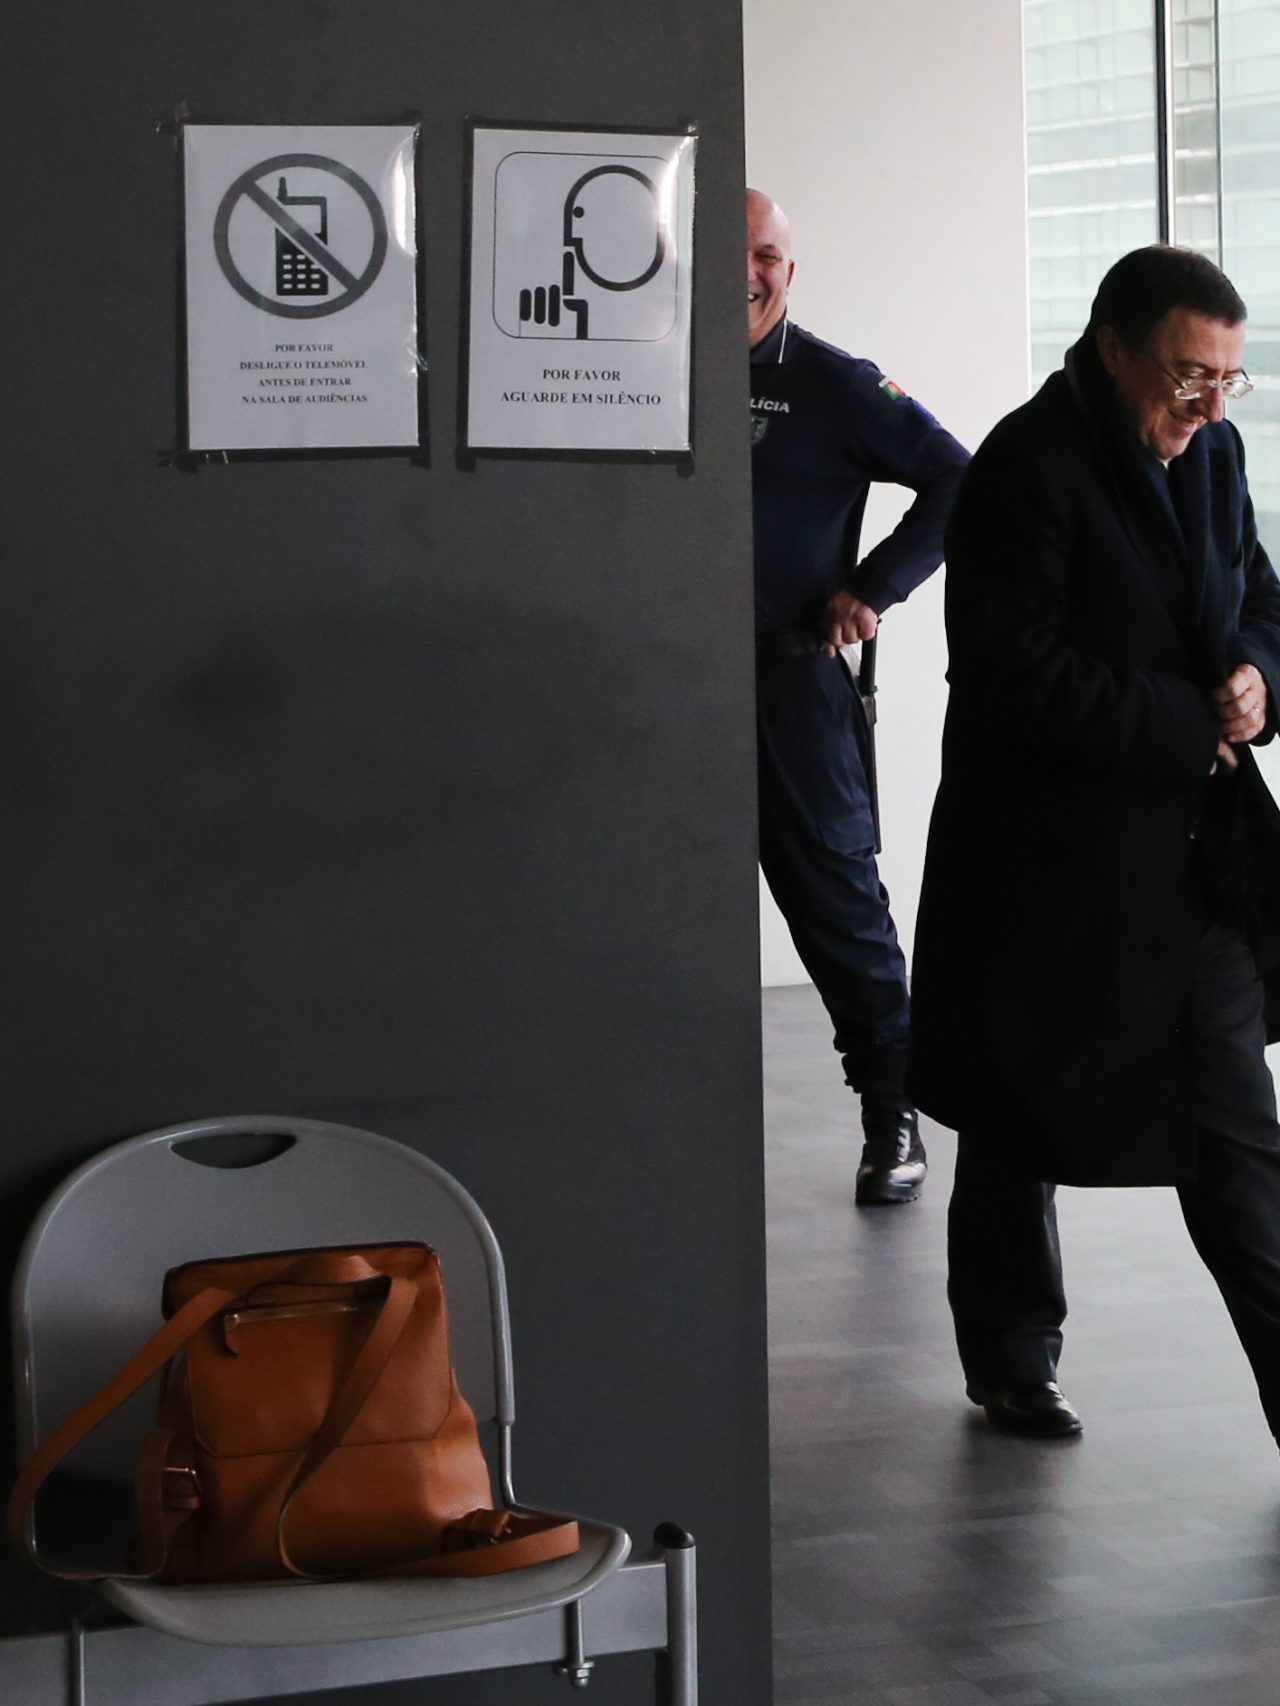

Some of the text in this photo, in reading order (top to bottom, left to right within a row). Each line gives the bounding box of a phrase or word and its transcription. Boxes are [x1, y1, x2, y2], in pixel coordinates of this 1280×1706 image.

[275, 344, 334, 352] POR FAVOR
[240, 360, 367, 370] DESLIGUE O TELEMÓVEL
[543, 369, 620, 381] POR FAVOR
[258, 378, 352, 387] ANTES DE ENTRAR
[242, 393, 368, 404] NA SALA DE AUDIÊNCIAS
[501, 391, 661, 405] AGUARDE EM SILÊNCIO
